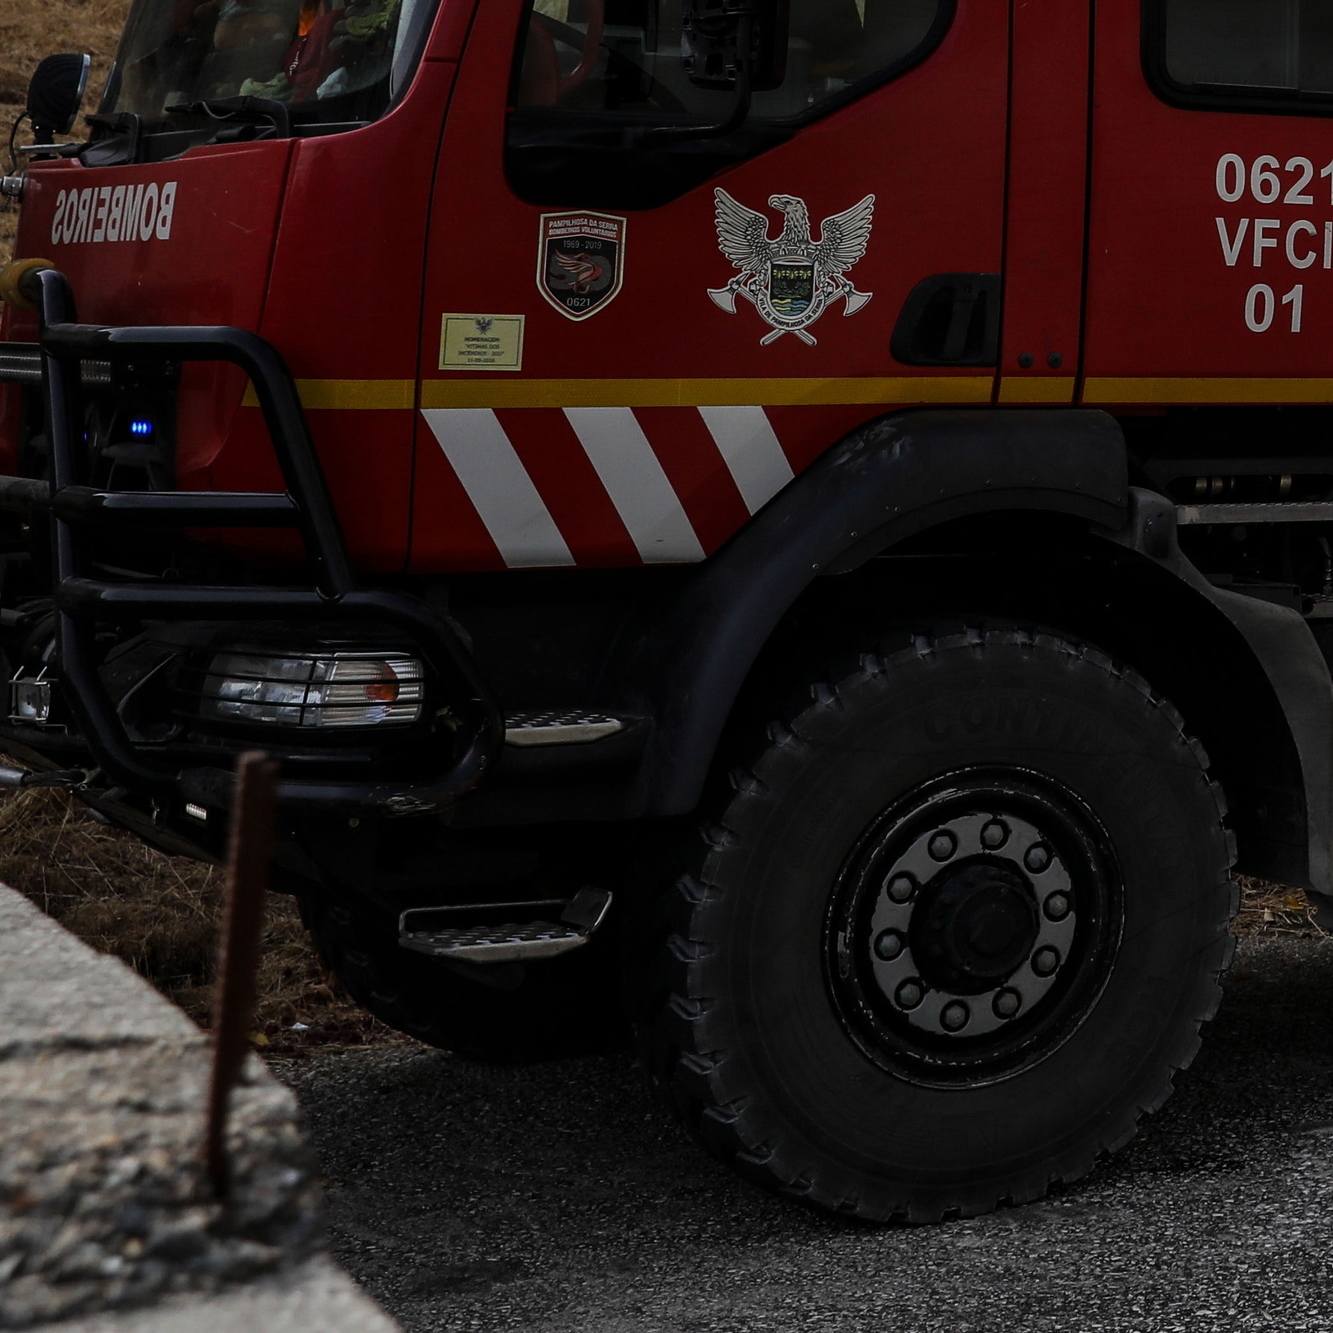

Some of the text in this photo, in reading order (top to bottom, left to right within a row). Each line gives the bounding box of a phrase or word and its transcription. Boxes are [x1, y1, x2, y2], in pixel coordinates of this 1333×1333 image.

[548, 218, 618, 231] PAMPILHOSA DA SERRA
[563, 240, 580, 249] 1969
[585, 241, 602, 250] 2019
[566, 297, 591, 307] 0621
[1244, 283, 1303, 333] 01
